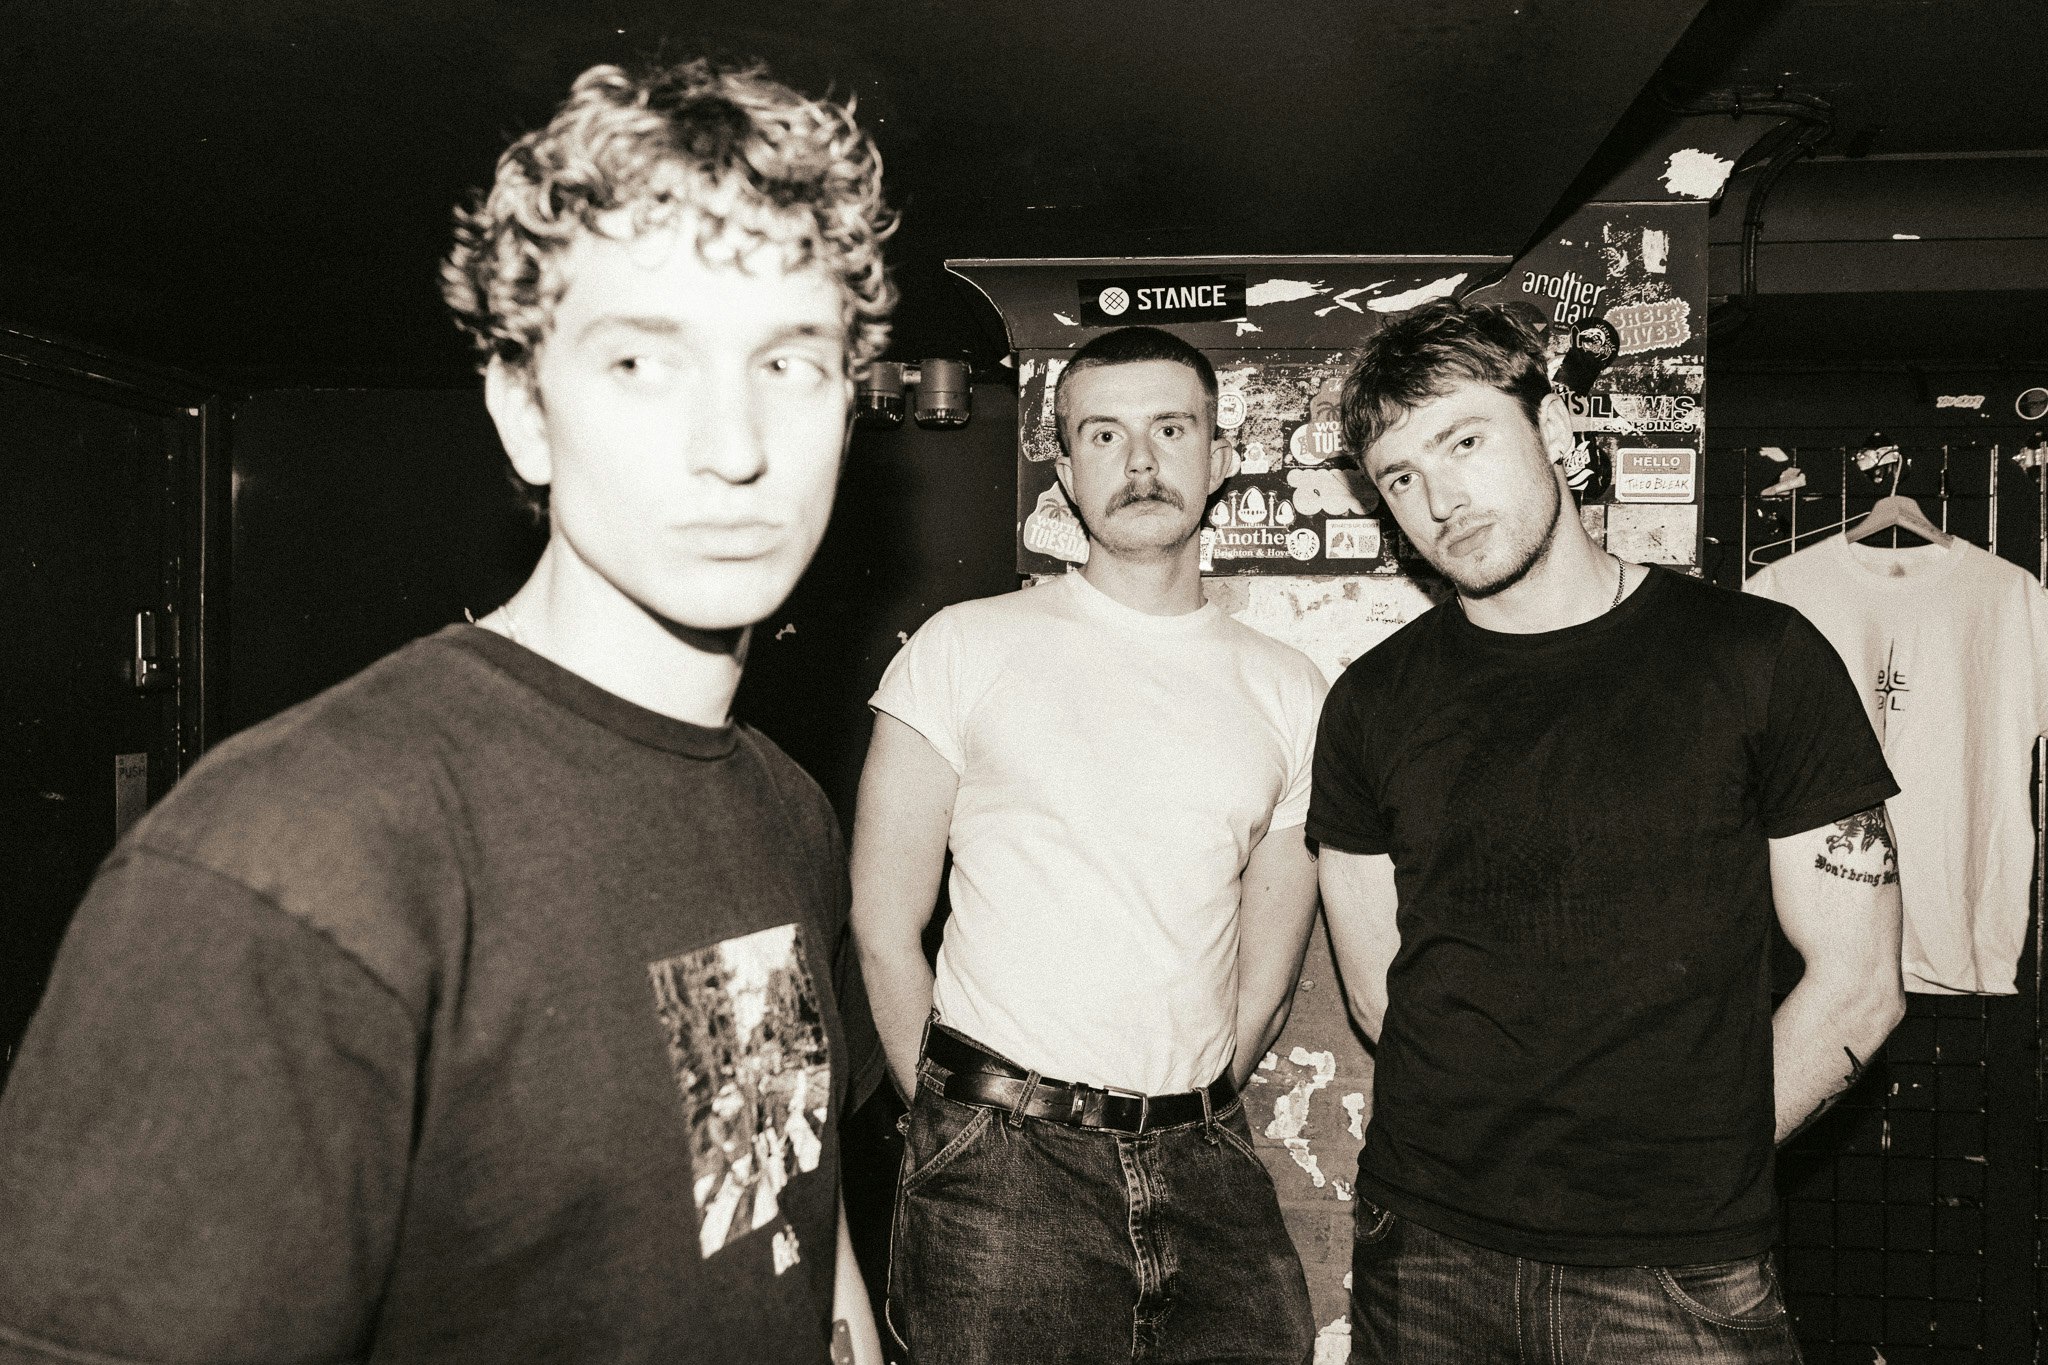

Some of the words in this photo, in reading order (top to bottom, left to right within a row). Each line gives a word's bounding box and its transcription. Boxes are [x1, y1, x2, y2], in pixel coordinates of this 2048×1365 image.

[1137, 284, 1227, 310] STANCE
[1522, 270, 1607, 306] another
[1614, 307, 1681, 330] SHELF
[1619, 322, 1680, 348] LIVES
[1590, 395, 1696, 420] LWIS
[1633, 456, 1680, 467] HELLO
[1653, 478, 1690, 491] BLEAK
[1030, 523, 1089, 562] TUESDA
[1215, 529, 1291, 545] Another
[1256, 549, 1265, 557] &
[119, 765, 146, 779] PUSH
[1848, 868, 1882, 887] bring
